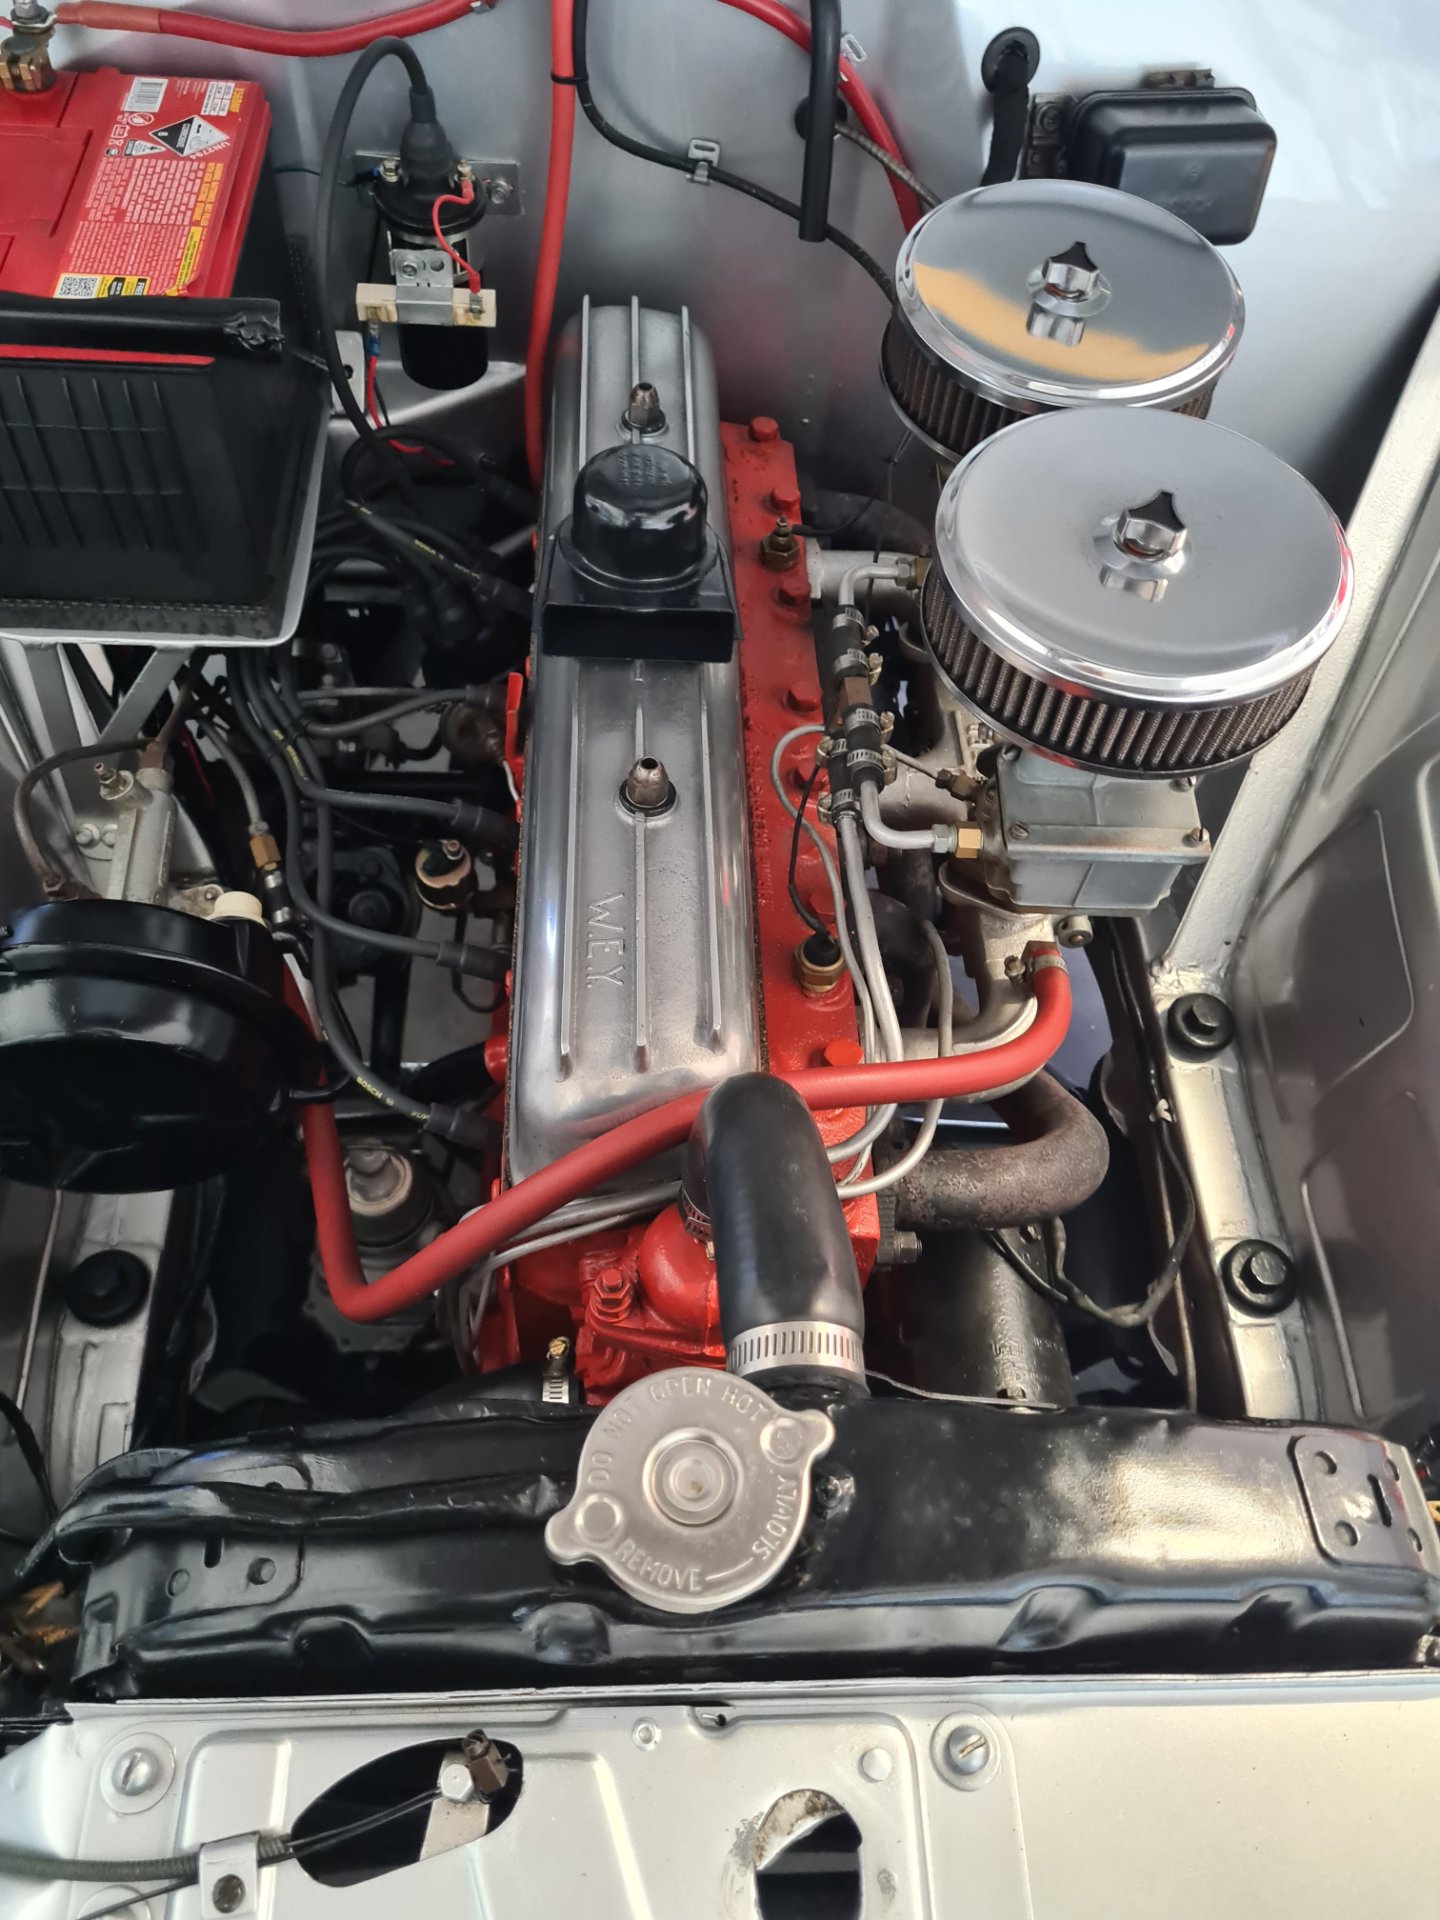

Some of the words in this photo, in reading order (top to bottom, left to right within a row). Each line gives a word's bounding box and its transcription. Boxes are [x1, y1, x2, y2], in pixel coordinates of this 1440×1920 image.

[356, 1076, 383, 1098] BOSCH
[588, 1453, 613, 1485] DO
[602, 1393, 640, 1440] NOT
[649, 1376, 712, 1402] OPEN
[722, 1386, 770, 1422] HOT
[615, 1538, 703, 1592] REMOVE
[752, 1473, 799, 1560] SLOWLY
